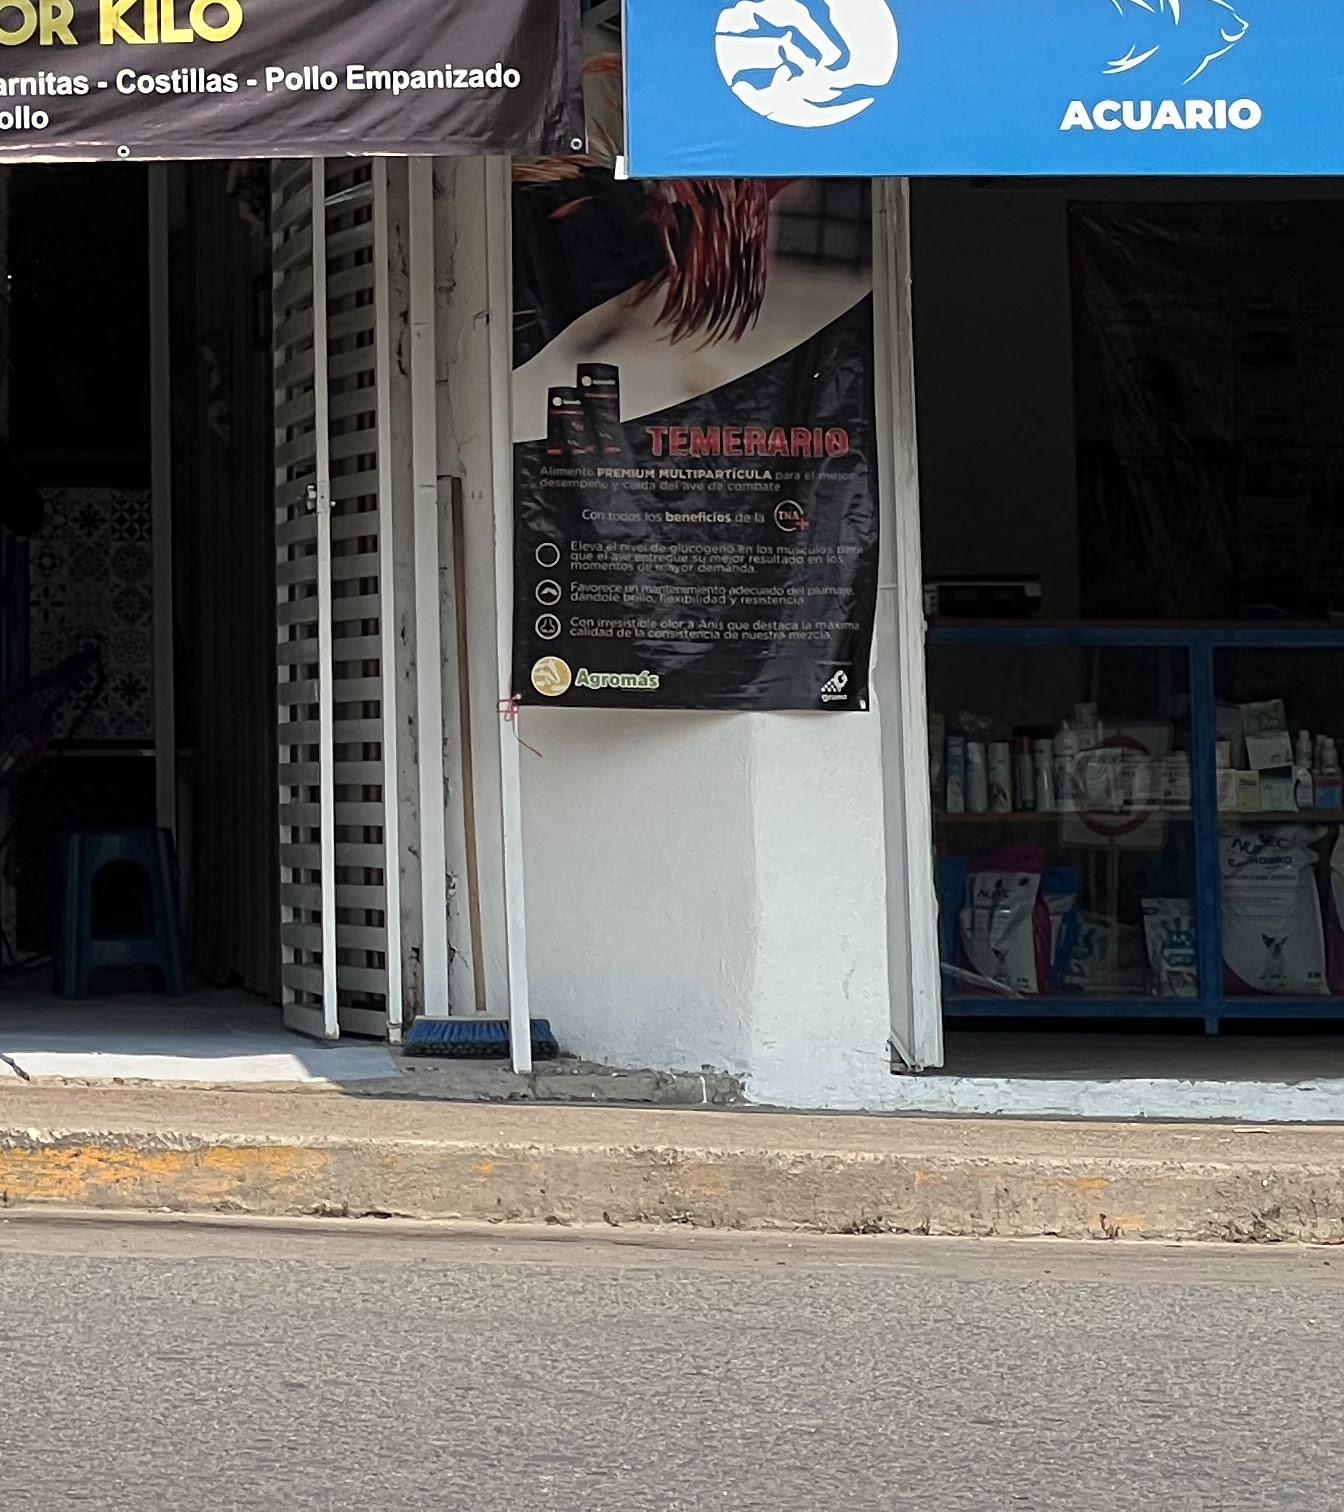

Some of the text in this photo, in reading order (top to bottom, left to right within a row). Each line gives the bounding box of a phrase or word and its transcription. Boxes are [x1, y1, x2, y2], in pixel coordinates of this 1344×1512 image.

[116, 69, 237, 96] Costillas
[265, 66, 339, 93] Pollo
[346, 64, 521, 96] Empanizado
[1060, 99, 1262, 131] ACUARIO
[646, 426, 849, 458] TEMERARIO
[597, 467, 655, 479] PREMIUM
[659, 468, 772, 480] MULTIPARTÍCULA
[665, 511, 731, 523] beneficios
[575, 668, 660, 690] Agromás
